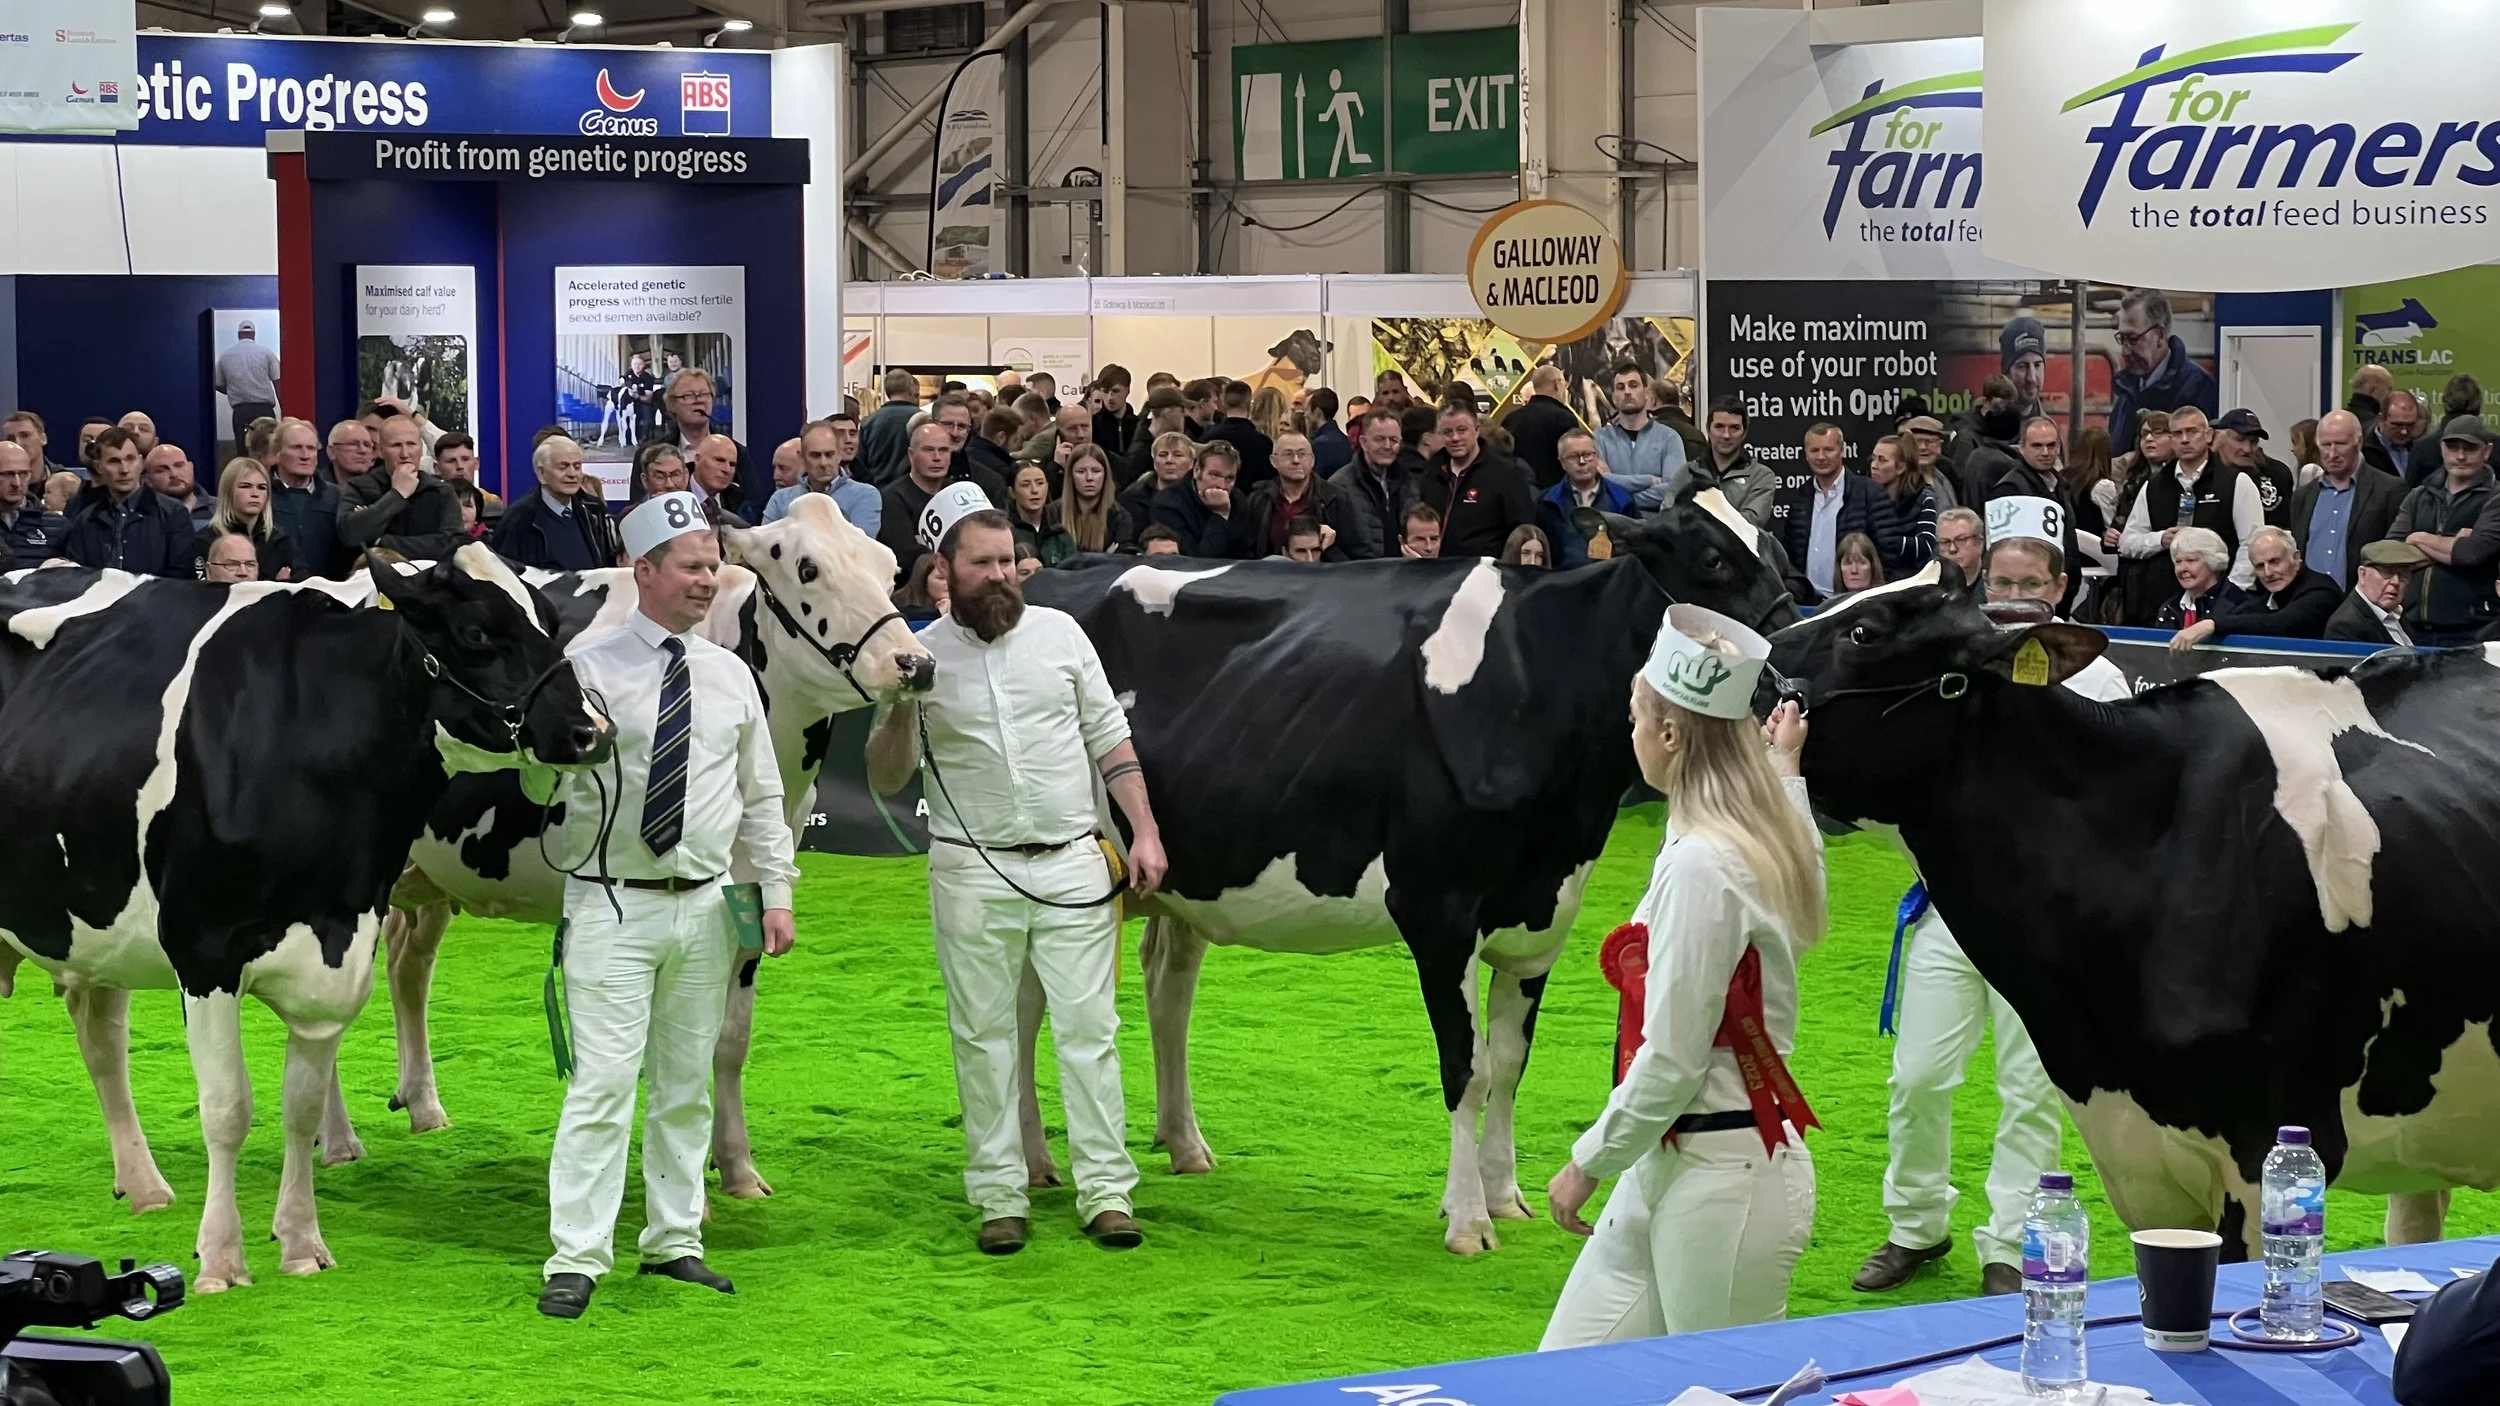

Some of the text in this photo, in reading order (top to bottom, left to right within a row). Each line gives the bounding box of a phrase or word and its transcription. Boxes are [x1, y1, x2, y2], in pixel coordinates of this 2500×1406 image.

[227, 62, 428, 131] Progress
[682, 81, 729, 108] ABS
[1428, 74, 1514, 132] EXIT
[2166, 75, 2251, 122] for
[579, 109, 658, 137] Genus
[1884, 108, 1943, 149] for
[377, 139, 748, 179] Profit from genetic progress
[2078, 114, 2500, 229] farmers
[2130, 200, 2487, 228] the total feed business
[1860, 220, 1895, 242] the
[1901, 219, 1954, 242] total
[1493, 235, 1602, 269] GALLOWAY
[365, 284, 456, 297] Maximised calf value
[568, 279, 686, 292] Accelerated genetic
[1486, 274, 1600, 307] & MACLEOD
[365, 304, 446, 318] for your dairy herd?
[569, 295, 733, 308] progress with the most fertile
[569, 311, 702, 323] sexed semen available?
[1730, 314, 1927, 341] Make maximum
[1730, 350, 1937, 384] use of your robot
[2353, 349, 2454, 365] TRANSLAC
[1790, 389, 1842, 417] with
[664, 497, 709, 529] 84
